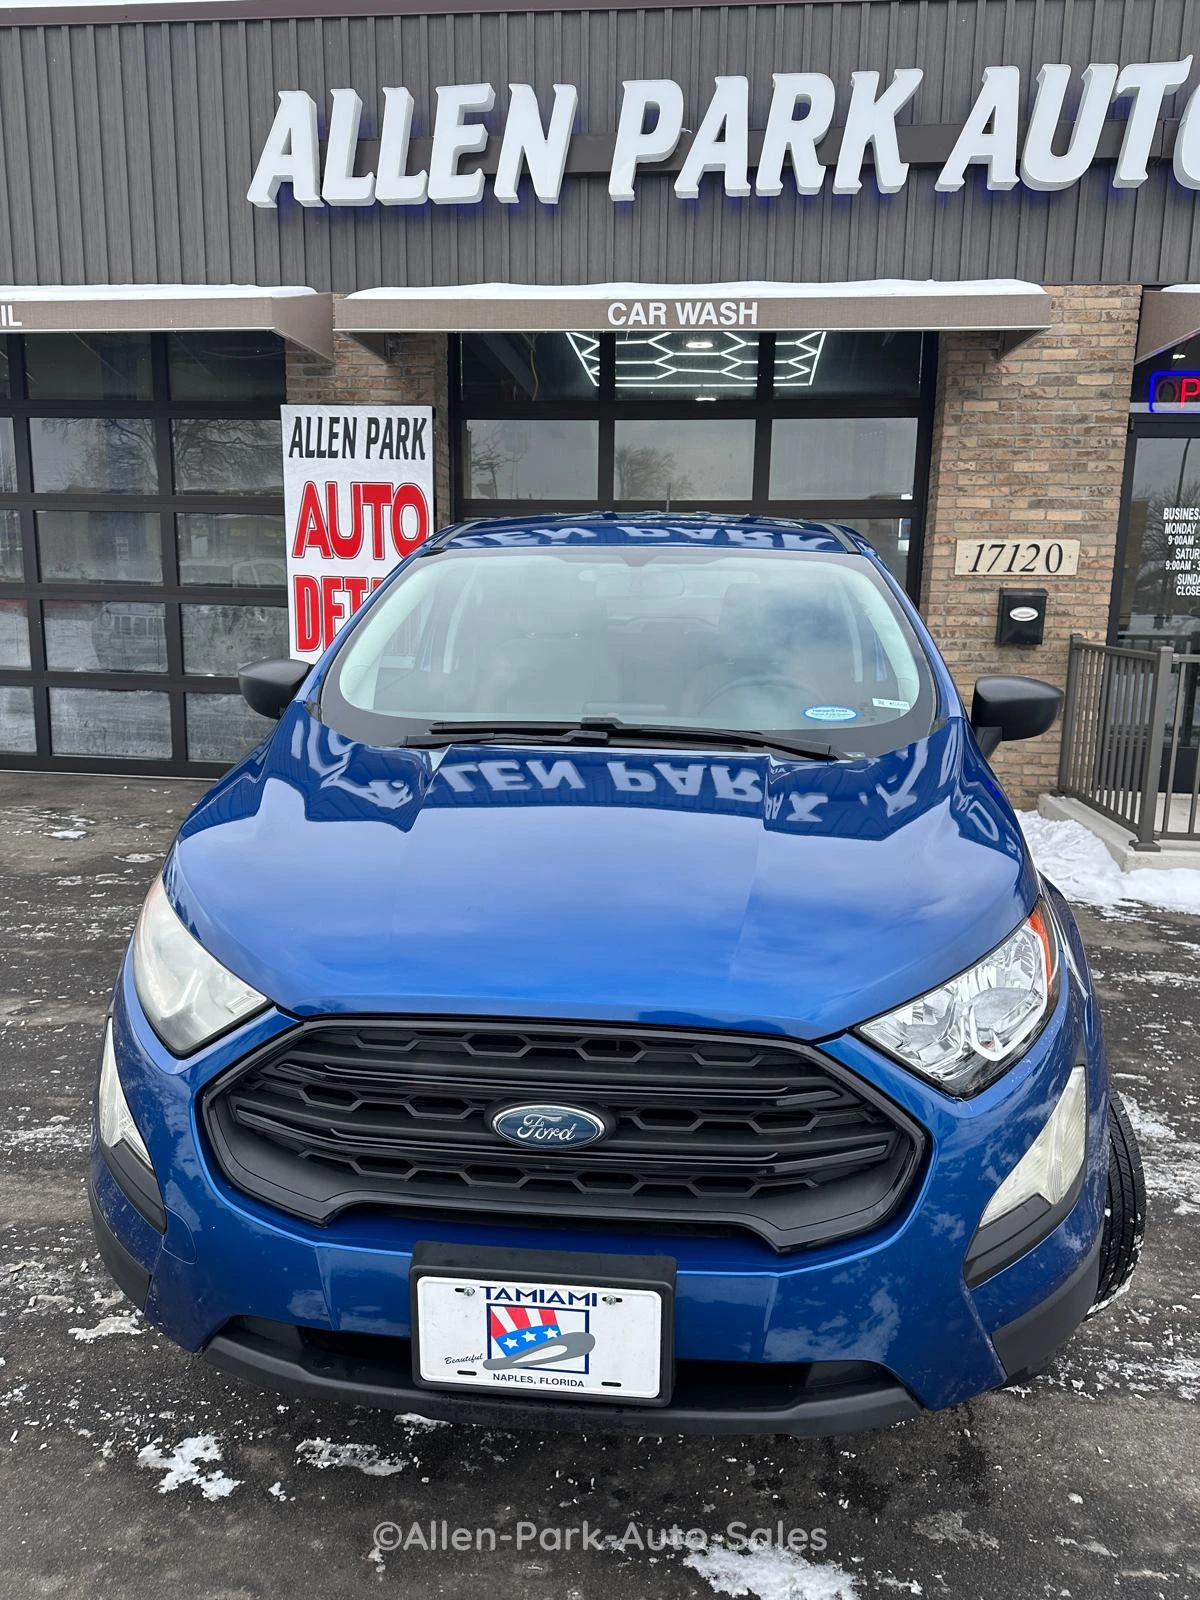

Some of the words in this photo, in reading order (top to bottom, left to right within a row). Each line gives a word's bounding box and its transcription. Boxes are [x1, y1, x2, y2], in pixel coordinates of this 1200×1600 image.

[247, 83, 578, 208] ALLEN
[609, 68, 923, 201] PARK
[0, 304, 23, 327] IL
[607, 302, 667, 326] CAR
[675, 301, 758, 325] WASH
[288, 415, 358, 459] ALLEN
[365, 417, 427, 461] PARK
[292, 481, 430, 561] AUTO
[1163, 507, 1200, 521] BUSINES
[1164, 522, 1197, 535] MONDAY
[1167, 535, 1195, 546] 9:00AM
[968, 543, 1063, 573] 17120
[1165, 560, 1192, 571] 9:00AM
[293, 574, 386, 653] DET
[517, 1113, 577, 1141] Ford
[480, 1286, 597, 1307] TAMIAMI
[444, 1353, 484, 1365] Beautiful
[493, 1373, 537, 1386] NAPLES,
[539, 1377, 585, 1388] FLORIDA
